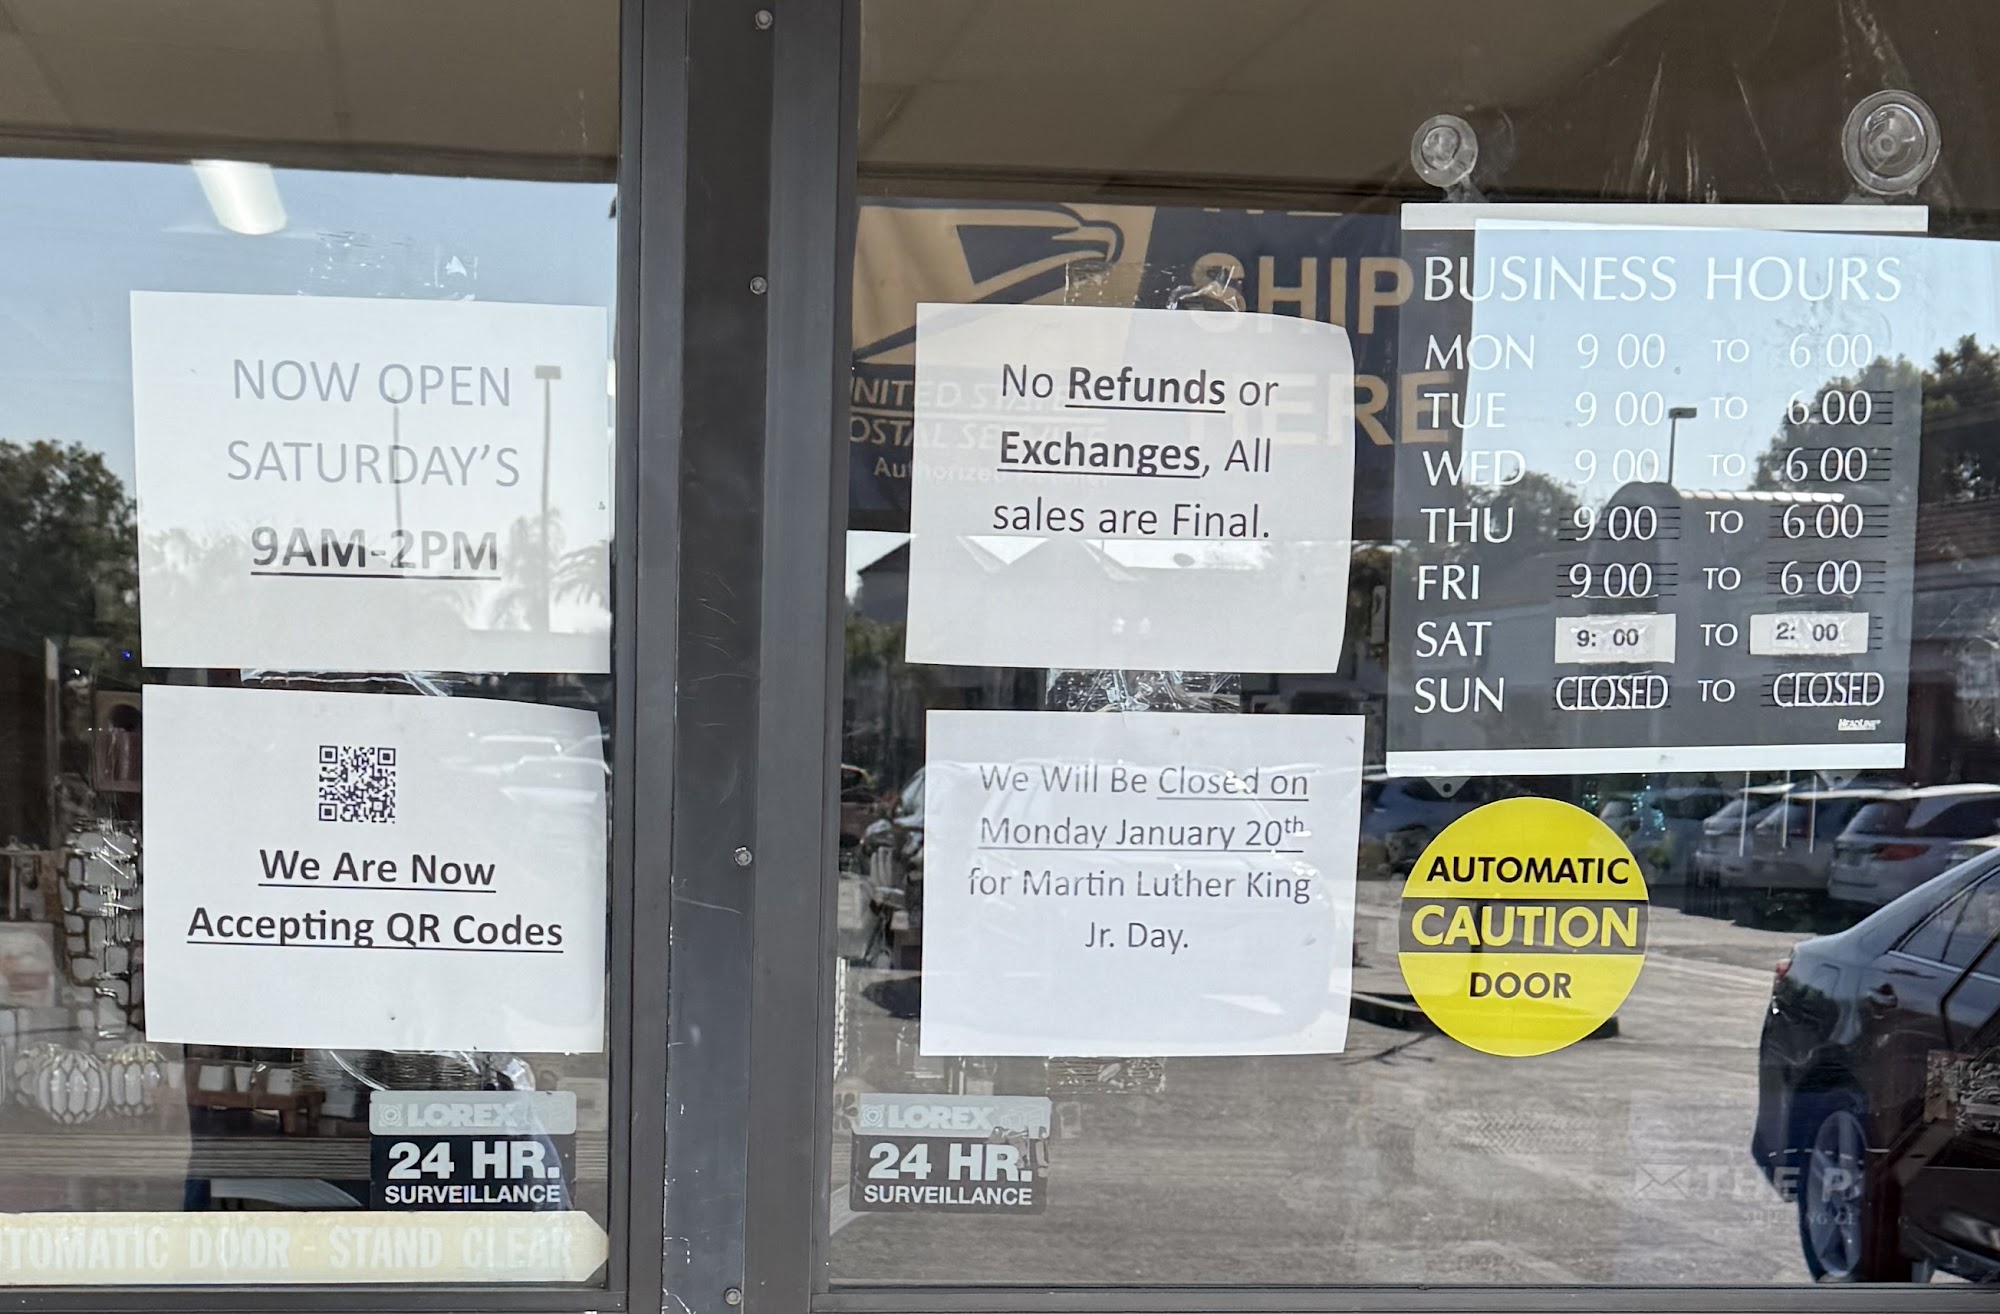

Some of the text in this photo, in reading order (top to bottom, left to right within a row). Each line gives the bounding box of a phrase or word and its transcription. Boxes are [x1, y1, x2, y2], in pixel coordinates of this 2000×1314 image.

[1191, 252, 1414, 335] SHIP
[1423, 254, 1902, 302] BUSINESS HOURS
[1424, 333, 1535, 371] MON
[1712, 338, 1750, 363] TO
[233, 359, 511, 407] NOW OPEN
[852, 377, 960, 407] NITED
[1002, 364, 1279, 407] No Refunds or
[1423, 391, 1507, 429] TUE
[1711, 395, 1748, 420] TO
[848, 417, 950, 449] OSTAL
[226, 440, 521, 487] SATURDAY’S
[1000, 431, 1271, 478] Exchanges, All
[1422, 450, 1526, 486] WED
[1709, 453, 1746, 477] TO
[992, 496, 1270, 538] sales are Final.
[1421, 508, 1514, 544] THU
[1706, 510, 1744, 534] TO
[251, 526, 498, 571] 9AM-2PM
[1417, 565, 1480, 601] FRI
[1703, 567, 1741, 591] TO
[1415, 620, 1492, 657] SAT
[1701, 623, 1738, 647] TO
[1414, 671, 1885, 713] SUN CLOSED TO CLOSED
[980, 765, 1309, 797] We Will Be Closed on
[980, 815, 1305, 851] Monday January 20th
[259, 849, 496, 887] We Are Now
[968, 867, 1311, 905] for Martin Luther King
[1426, 856, 1630, 884] AUTOMATIC
[187, 907, 564, 947] Accepting QR Codes
[1085, 921, 1189, 955] Jr. Day.
[1411, 905, 1639, 947] CAUTION
[1469, 972, 1572, 999] DOOR
[408, 1103, 517, 1128] LOREX
[888, 1104, 994, 1130] LOREX
[388, 1141, 560, 1179] 24 HR.
[868, 1142, 1032, 1182] 24 HR.
[384, 1184, 561, 1205] SURVEILLANCE
[864, 1185, 1032, 1206] SURVEILLANCE
[0, 1227, 169, 1270] TOMATIC
[190, 1227, 291, 1269] DOOR
[328, 1226, 443, 1269] STAND
[462, 1226, 573, 1269] CLEAR
